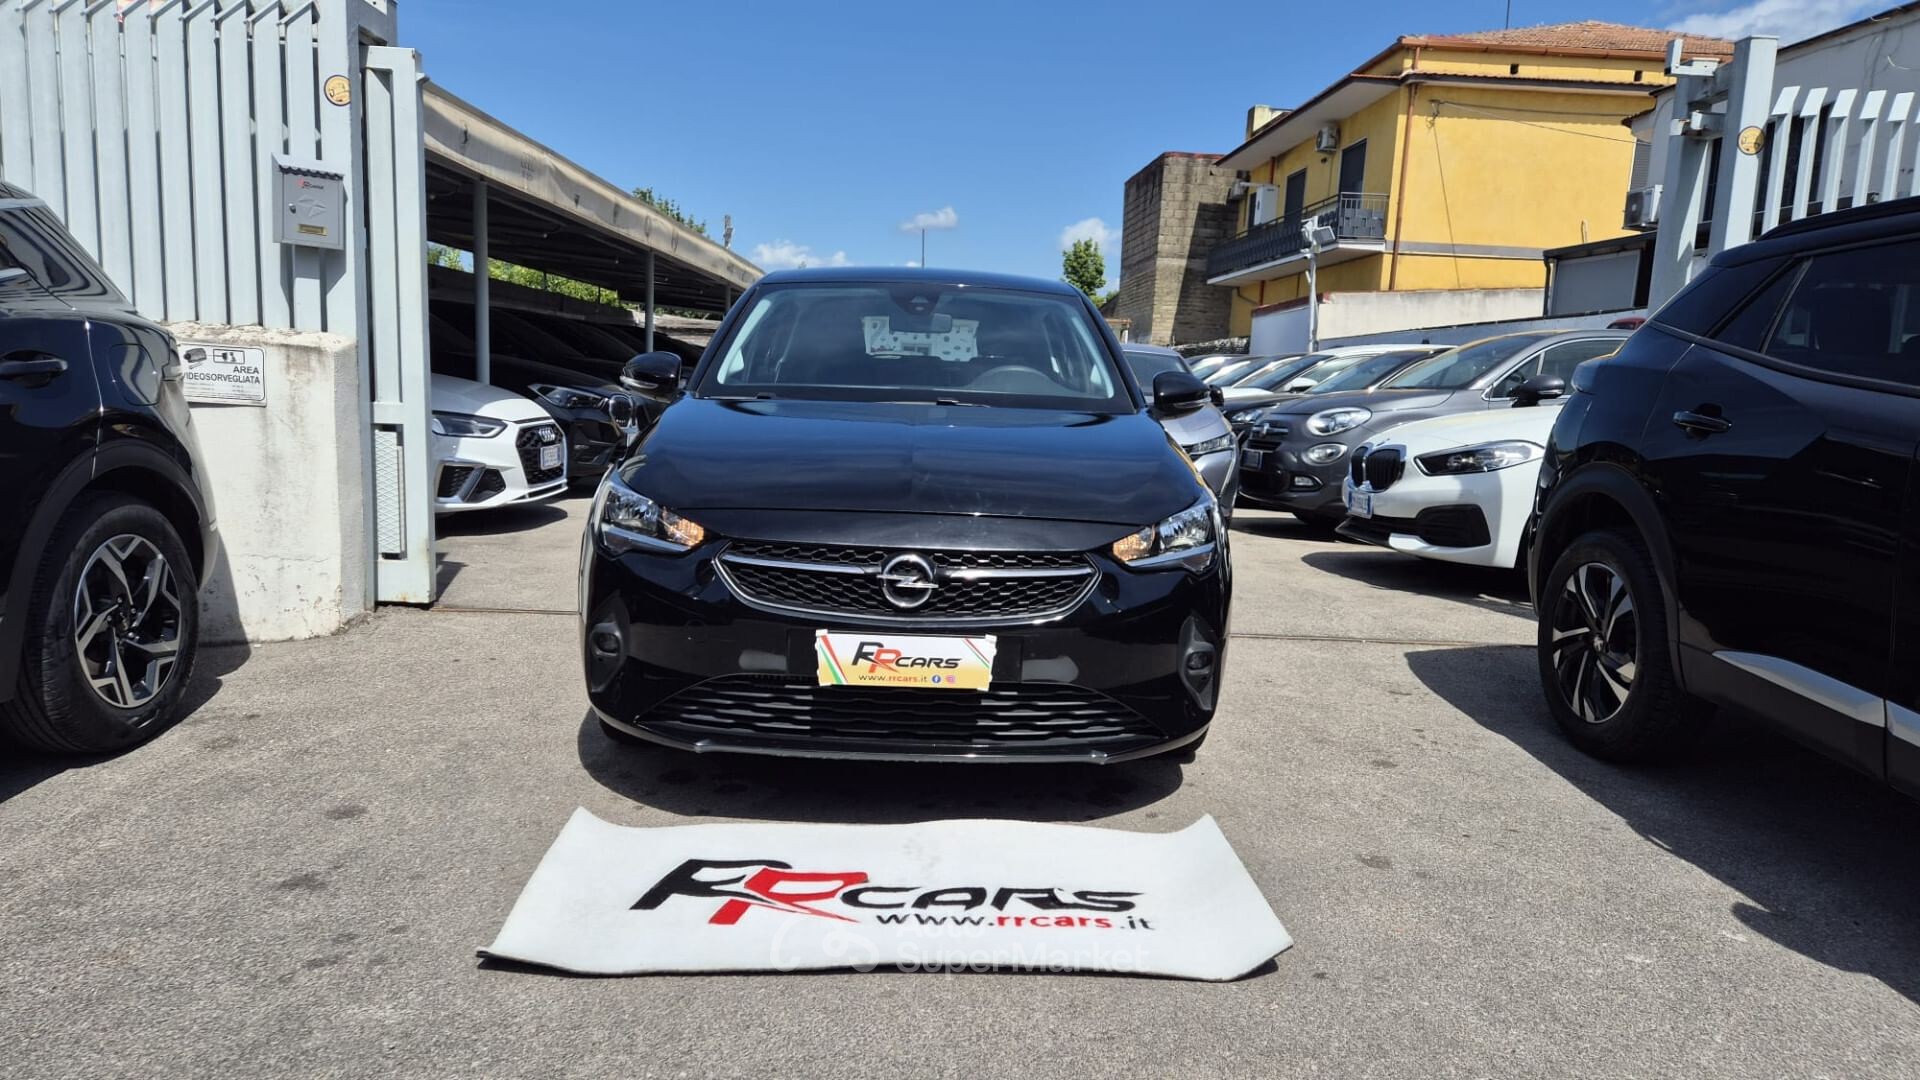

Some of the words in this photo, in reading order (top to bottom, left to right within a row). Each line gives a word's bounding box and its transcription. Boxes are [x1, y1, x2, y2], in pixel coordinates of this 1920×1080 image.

[233, 365, 260, 375] AREA
[858, 674, 928, 684] www.rrcars.it
[876, 911, 1156, 931] www.rrcars.it
